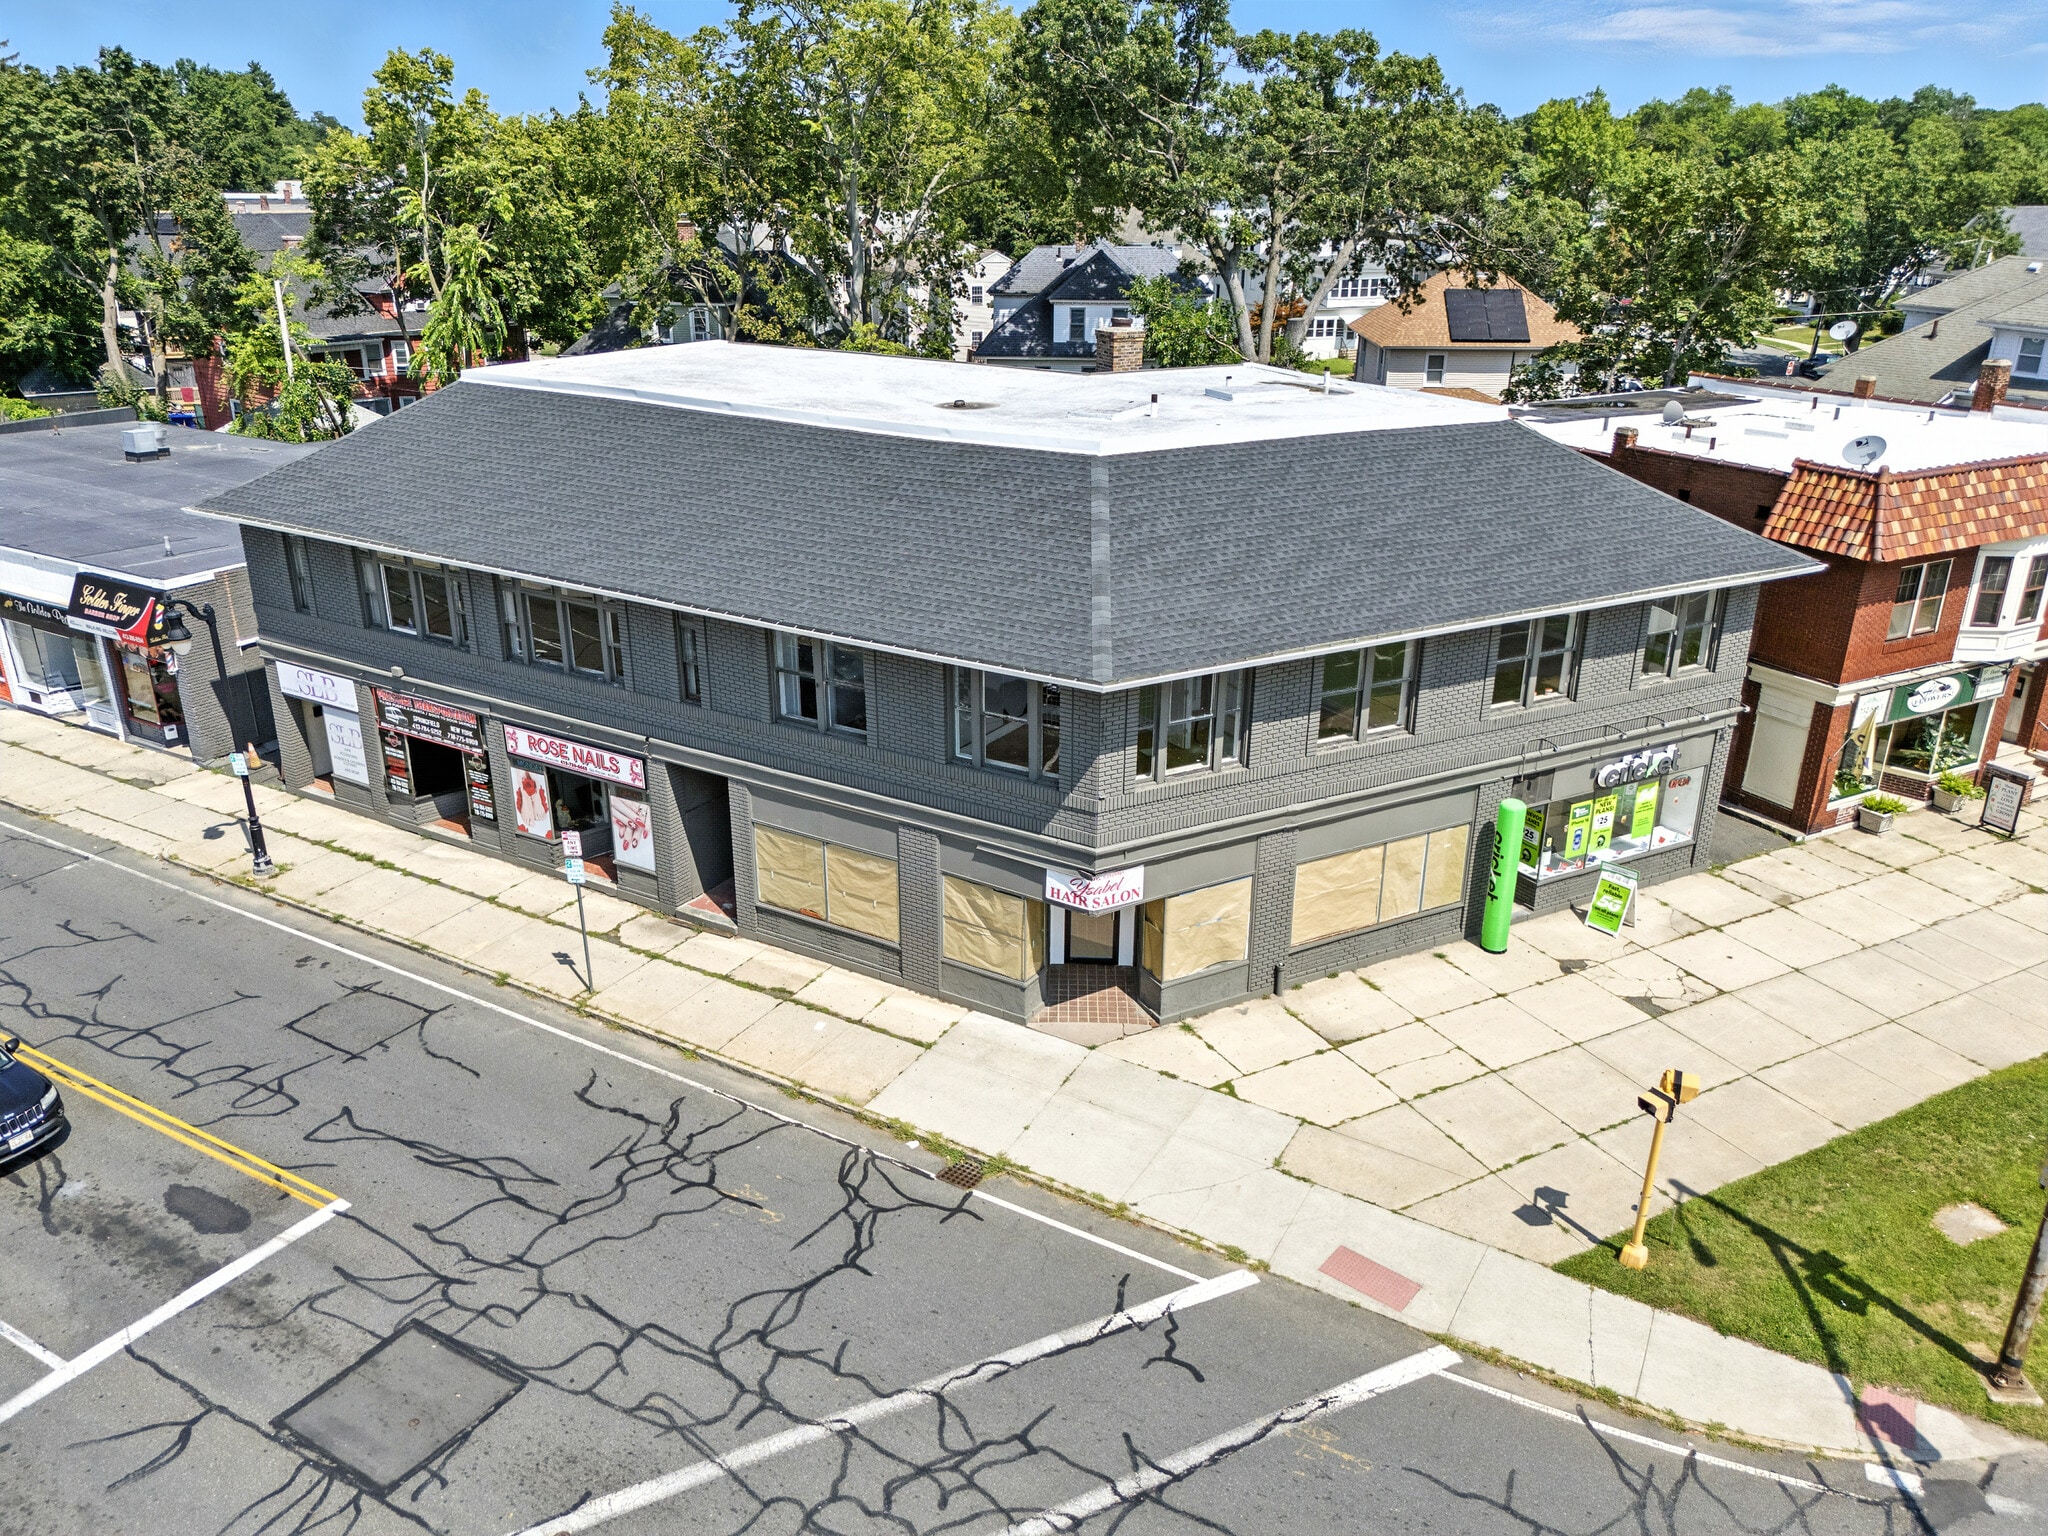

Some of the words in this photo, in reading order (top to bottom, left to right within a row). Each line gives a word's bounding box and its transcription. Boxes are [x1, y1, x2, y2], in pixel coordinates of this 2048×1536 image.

[80, 584, 110, 610] Golden
[110, 592, 141, 620] Finger
[84, 608, 105, 619] BARBER
[105, 613, 120, 622] SHOP
[527, 735, 570, 761] ROSE
[572, 746, 621, 774] NAILS
[1601, 745, 1681, 788] cricket
[1526, 816, 1540, 827] LANES
[1527, 811, 1542, 821] UEVOS
[1488, 831, 1504, 902] cricket
[1050, 887, 1088, 908] HAIR
[1092, 887, 1141, 909] SALON
[1596, 895, 1624, 912] 5G
